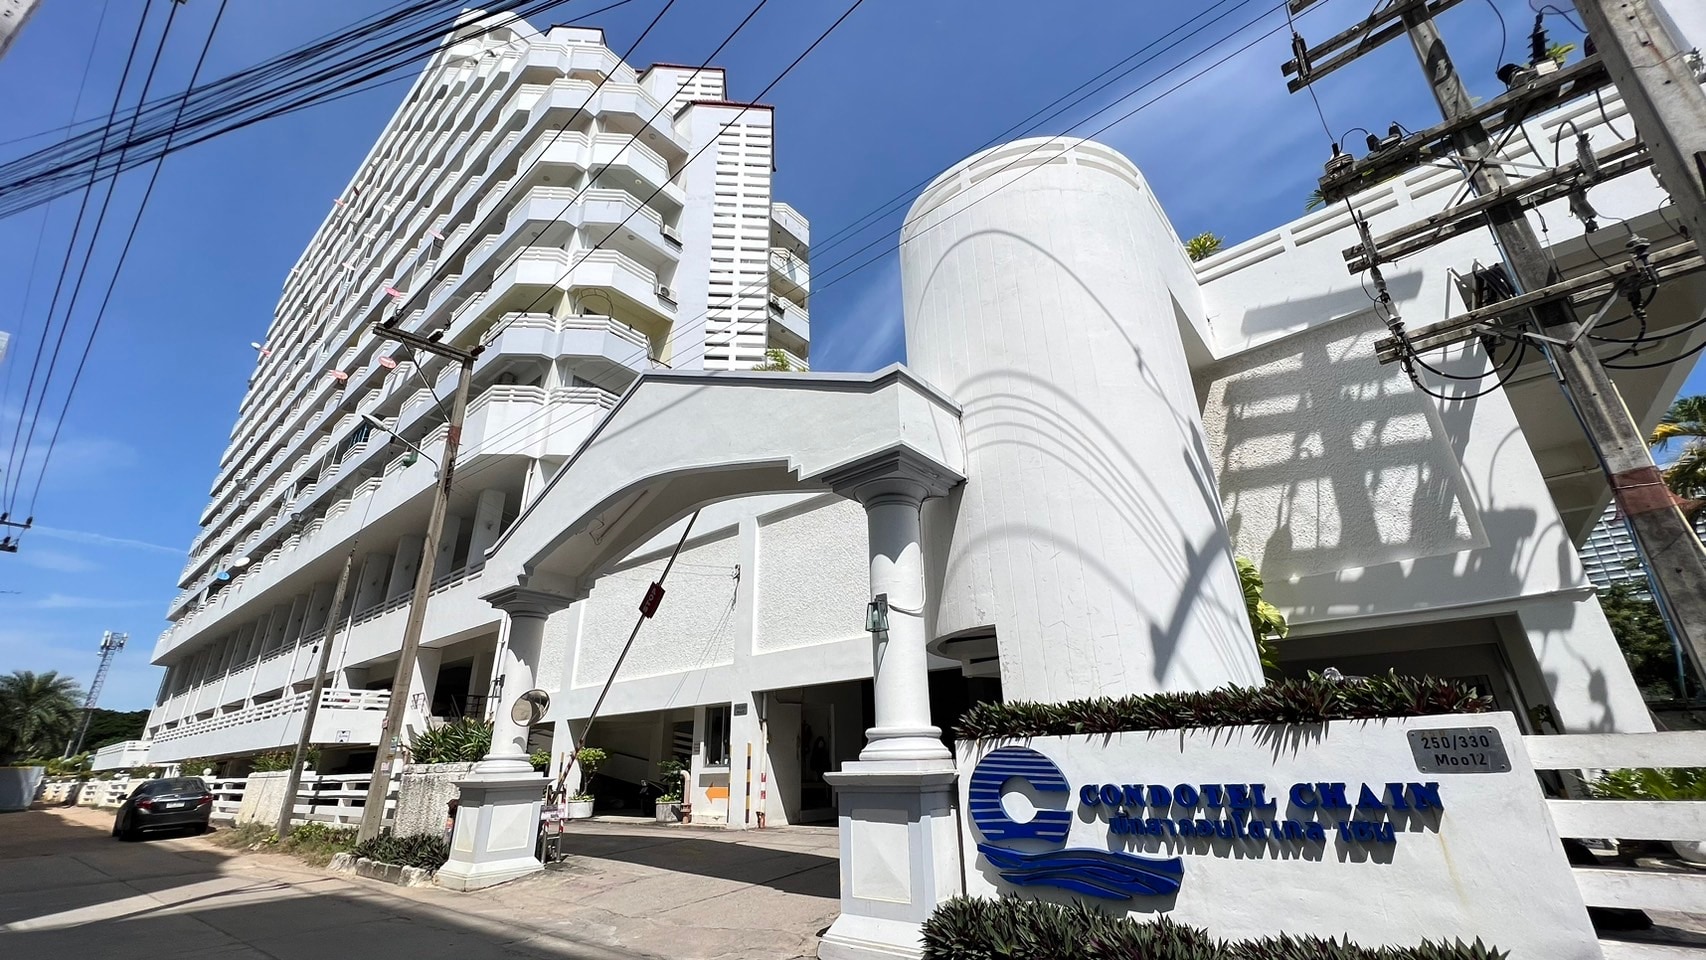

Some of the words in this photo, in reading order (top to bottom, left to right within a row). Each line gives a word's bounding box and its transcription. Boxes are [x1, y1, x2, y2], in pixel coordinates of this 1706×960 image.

[642, 586, 656, 613] STOP
[1420, 734, 1490, 751] 250/330
[1434, 752, 1488, 767] Moo12
[1079, 783, 1277, 809] CONDOTEL
[1289, 782, 1445, 811] CHAIN
